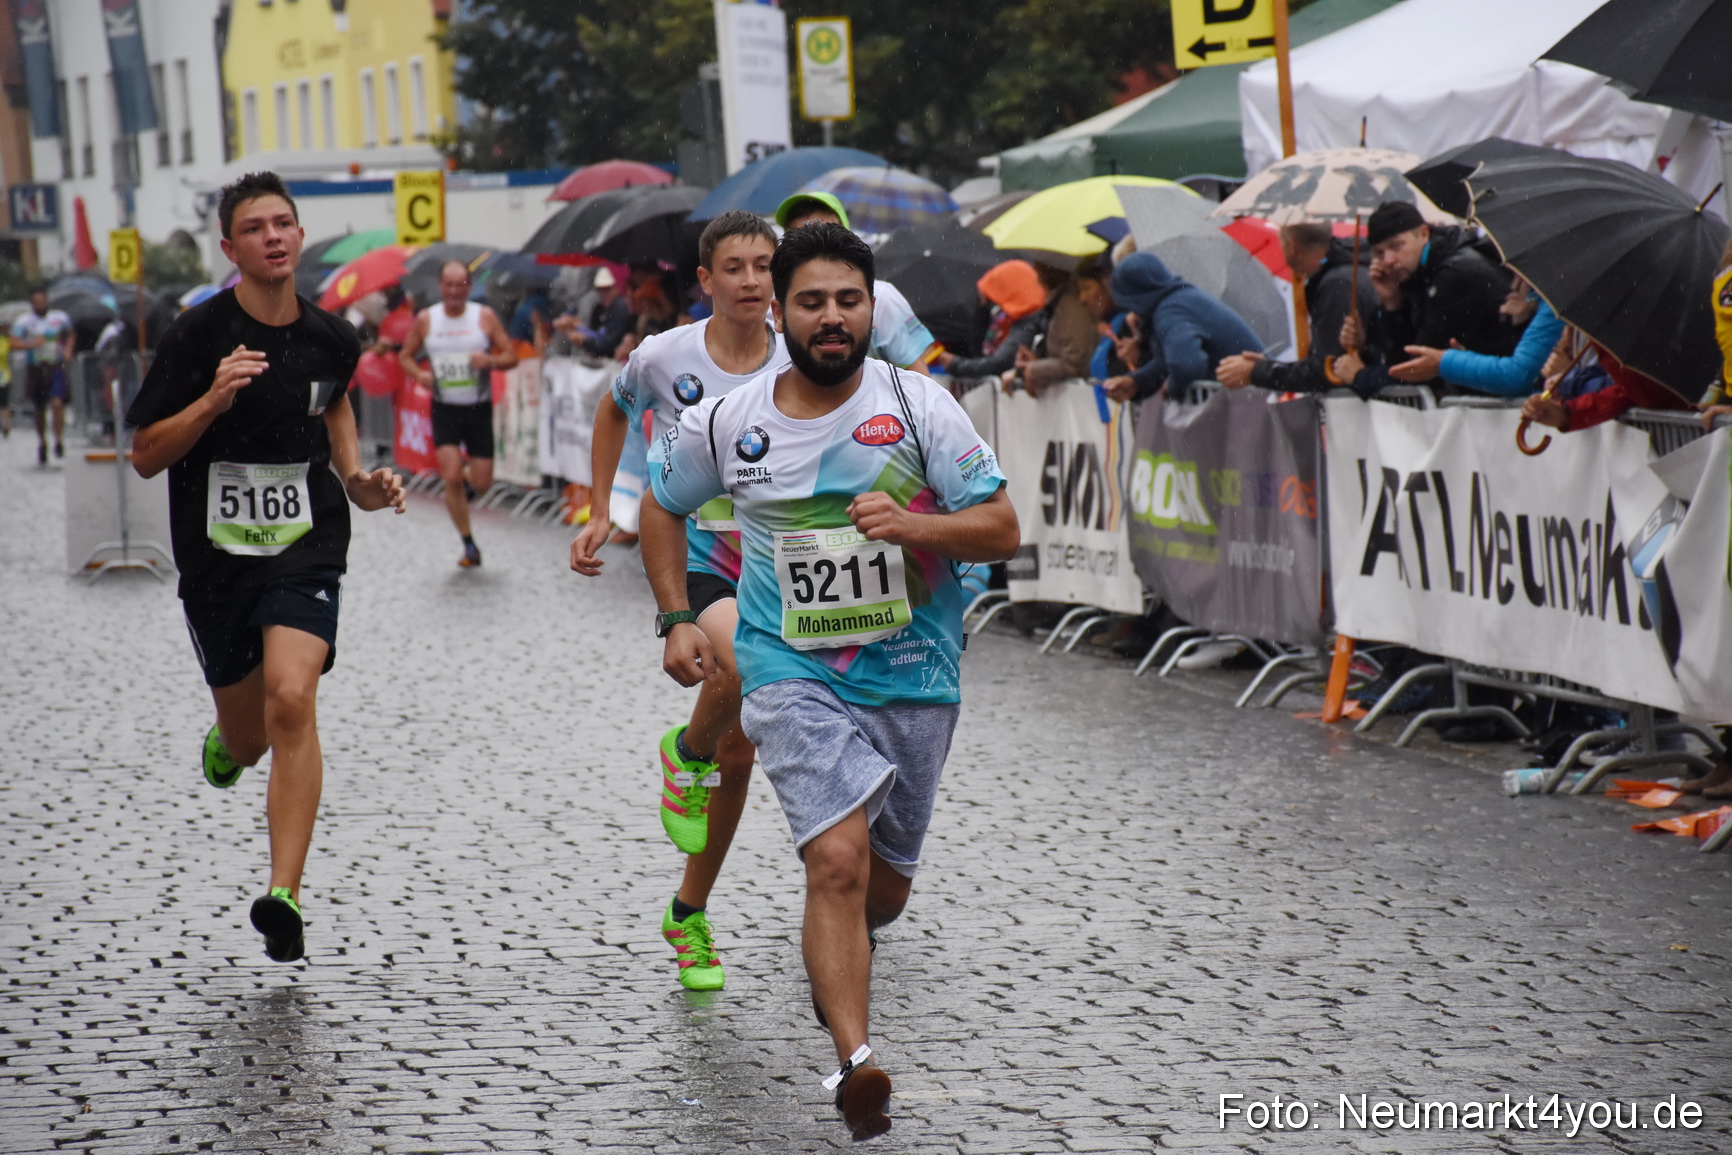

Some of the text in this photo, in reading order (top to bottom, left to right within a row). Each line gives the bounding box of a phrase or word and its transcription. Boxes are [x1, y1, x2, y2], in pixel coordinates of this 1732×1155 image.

[408, 193, 433, 230] C
[859, 421, 900, 438] Hervis
[254, 467, 300, 479] BOCK
[736, 466, 772, 479] PARTL
[736, 477, 773, 487] Neumarkt
[219, 484, 301, 521] 5168
[781, 544, 819, 554] NeuerMarkt
[788, 551, 890, 604] 5211
[797, 607, 895, 634] Mohammad
[888, 650, 930, 667] adtlauf
